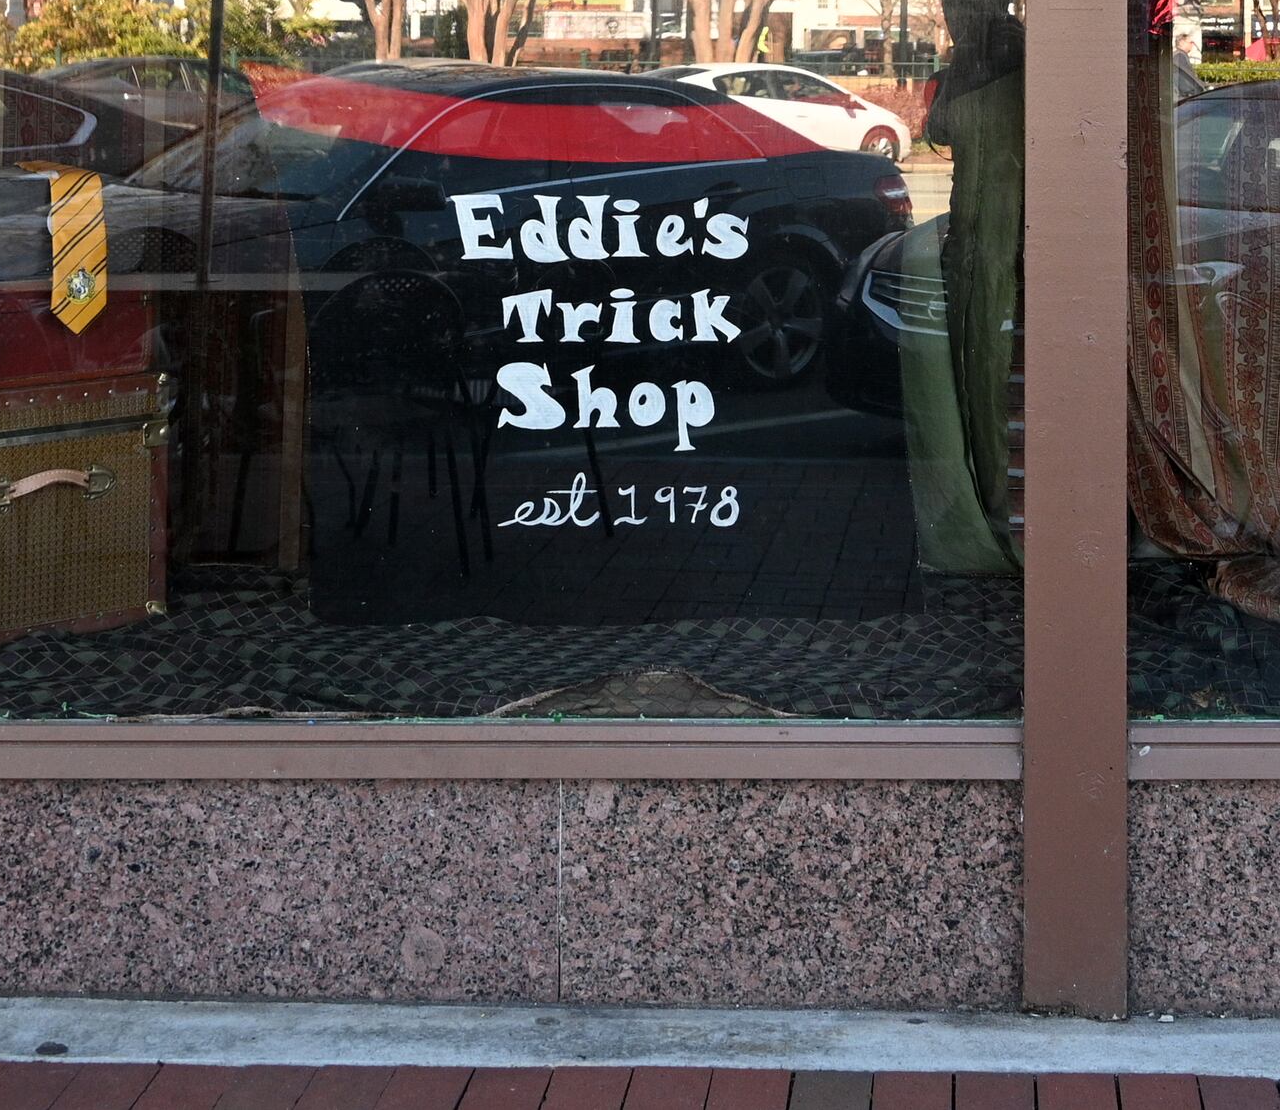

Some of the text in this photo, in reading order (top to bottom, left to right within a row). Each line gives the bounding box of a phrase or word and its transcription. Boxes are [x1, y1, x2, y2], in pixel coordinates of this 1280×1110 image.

[450, 194, 750, 264] Eddie's
[501, 287, 742, 343] Trick
[496, 362, 716, 452] Shop
[497, 472, 741, 527] est 1978
